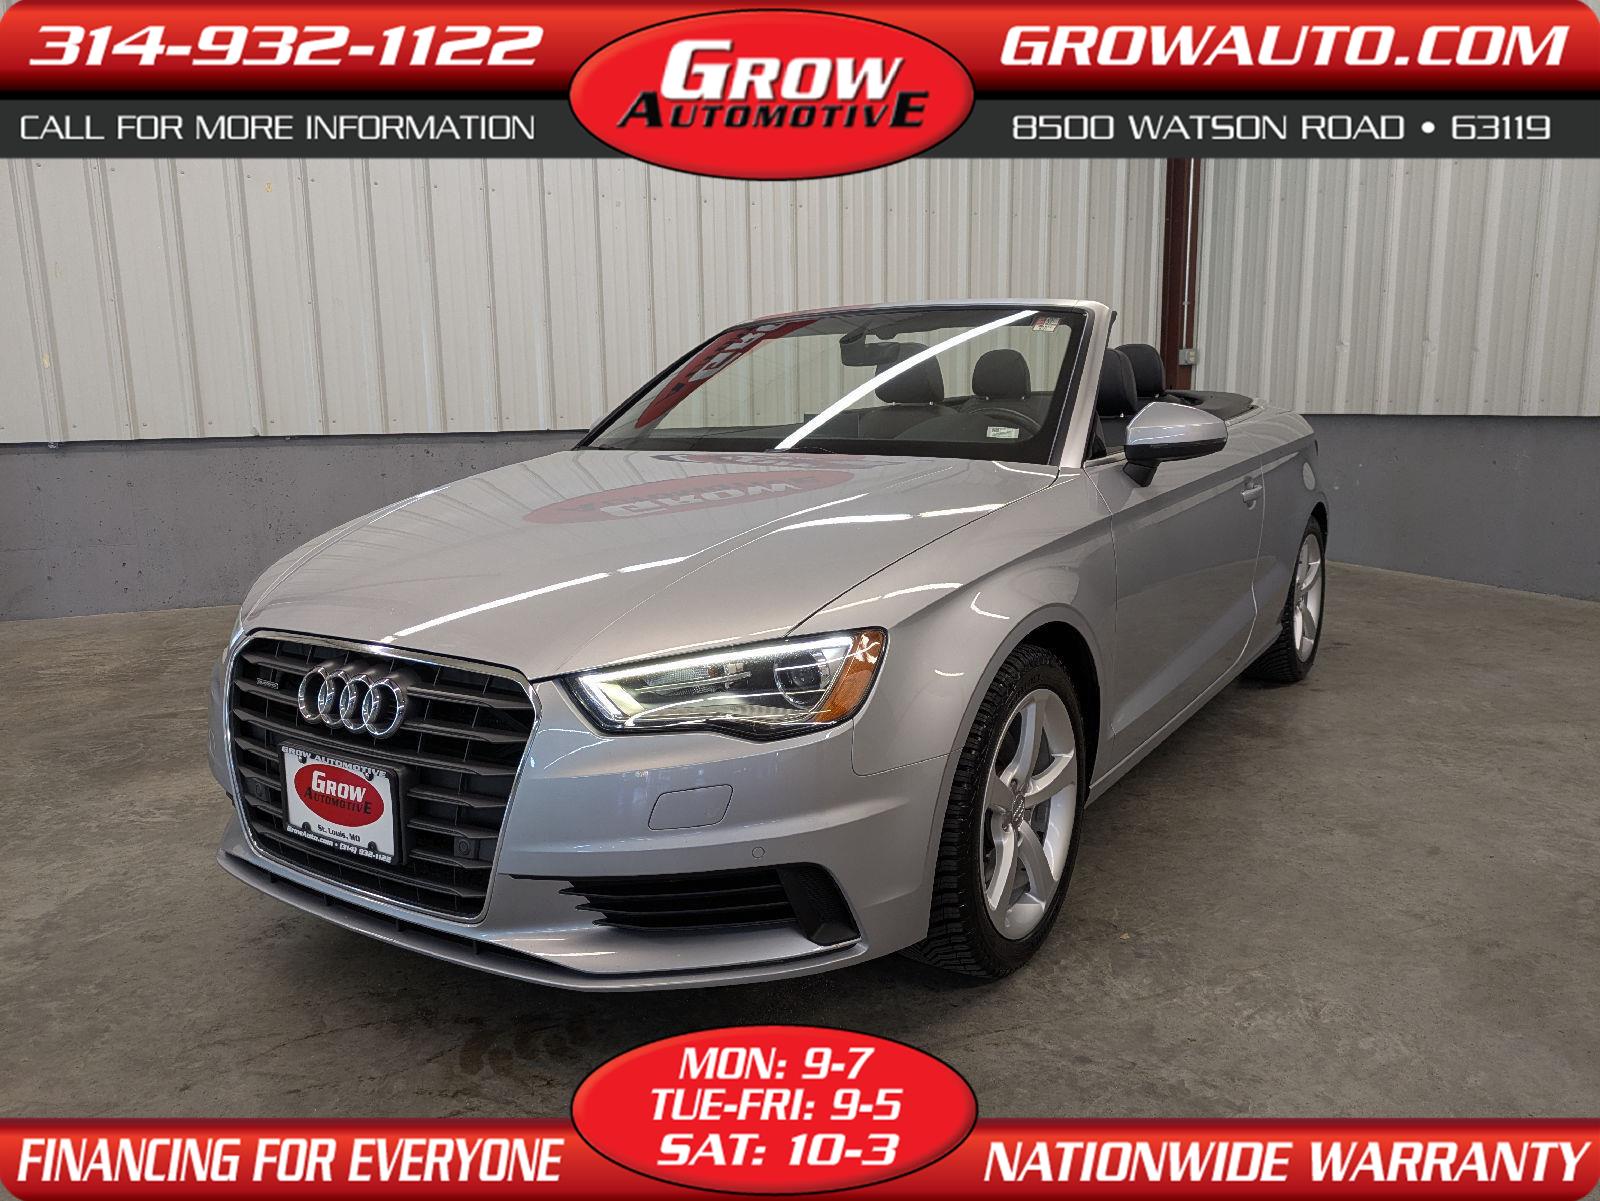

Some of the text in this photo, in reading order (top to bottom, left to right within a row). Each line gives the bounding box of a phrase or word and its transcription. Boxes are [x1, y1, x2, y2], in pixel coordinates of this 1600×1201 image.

[281, 745, 387, 779] GROW AUTOMOTIVE
[304, 787, 372, 815] AUTOMOTIVE
[311, 770, 367, 803] GROW
